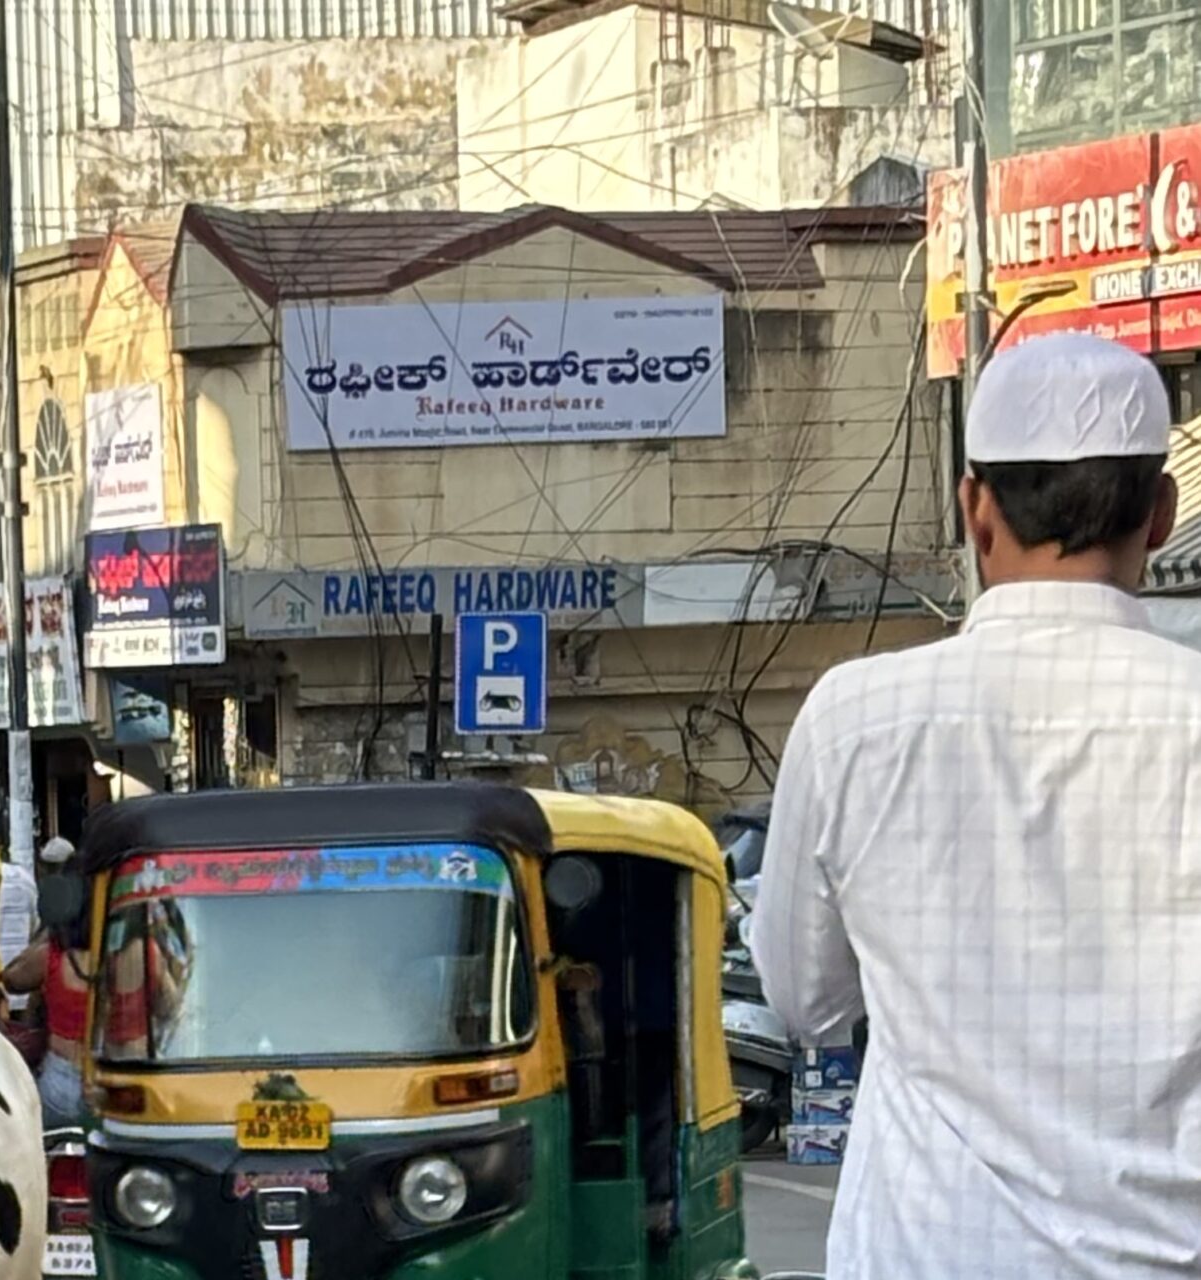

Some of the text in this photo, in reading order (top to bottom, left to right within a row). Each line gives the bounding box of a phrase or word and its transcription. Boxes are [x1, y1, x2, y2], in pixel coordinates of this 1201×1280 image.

[1176, 181, 1196, 238] &
[415, 395, 606, 421] Rafeeq Hardware
[323, 569, 618, 616] RAFEEQ HARDWARE
[483, 621, 518, 671] P
